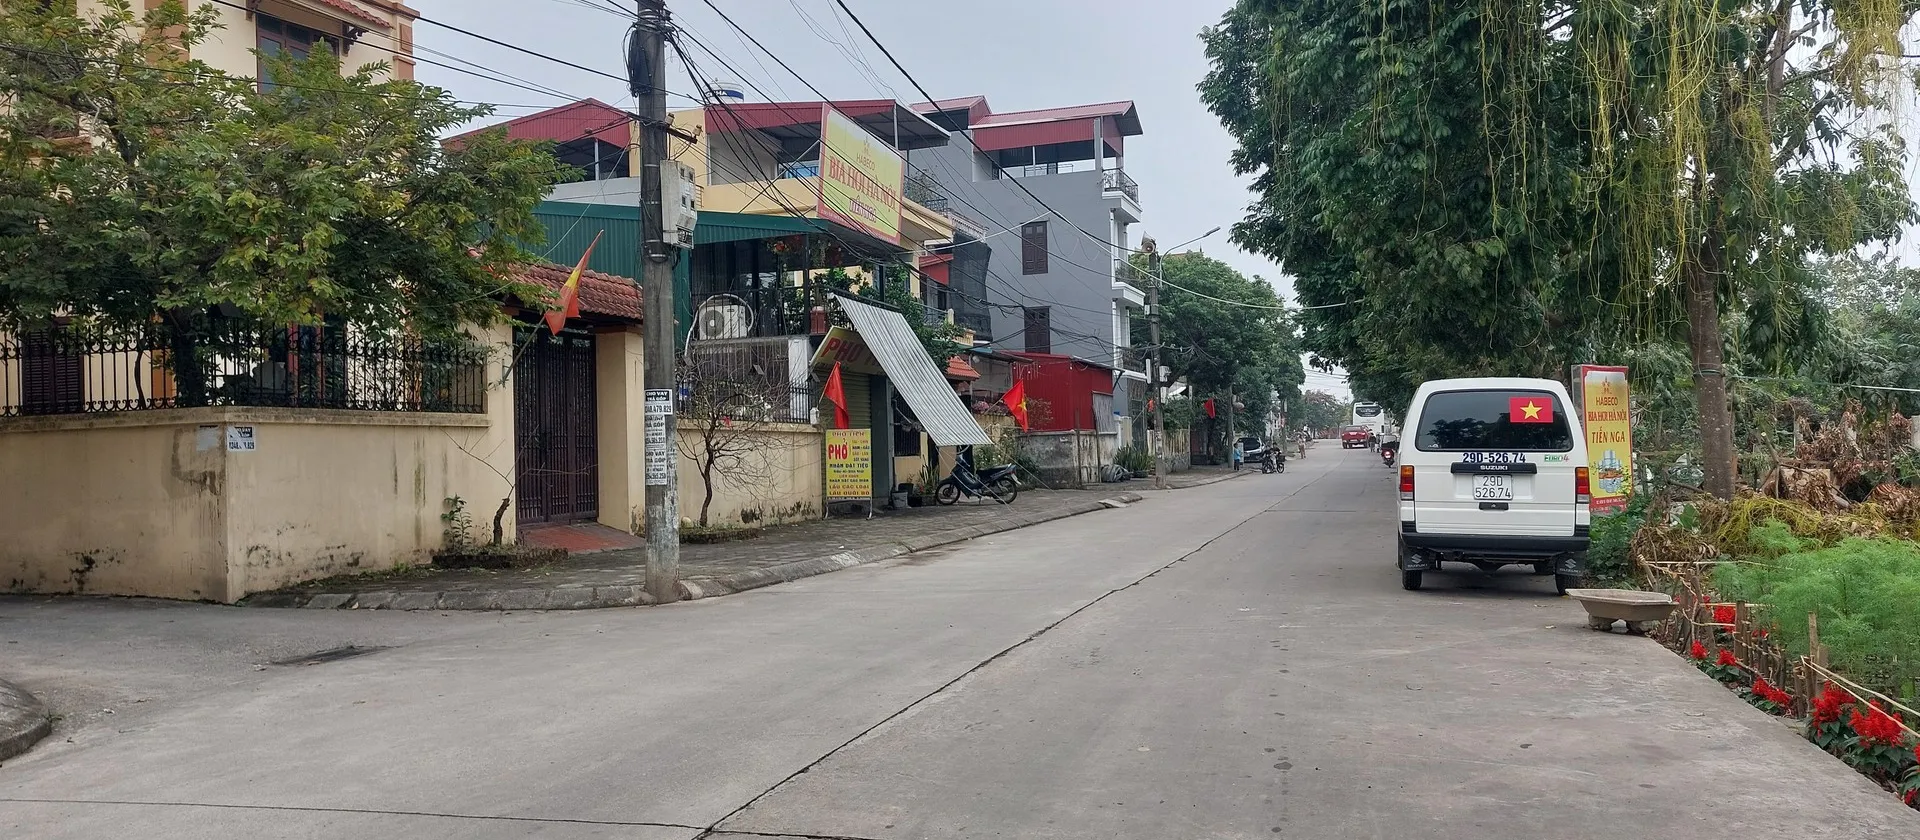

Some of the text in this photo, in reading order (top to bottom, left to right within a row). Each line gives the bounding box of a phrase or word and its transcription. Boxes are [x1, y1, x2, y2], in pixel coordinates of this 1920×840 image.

[828, 155, 846, 185] BIA
[1595, 396, 1619, 406] HABECO
[1587, 411, 1597, 421] BIA
[1608, 409, 1618, 421] HÀ
[1609, 431, 1625, 443] NGA
[828, 437, 848, 460] PHỞ
[1462, 452, 1526, 463] 29D-526.74
[1483, 475, 1503, 486] 29D
[1475, 487, 1511, 498] 526.74
